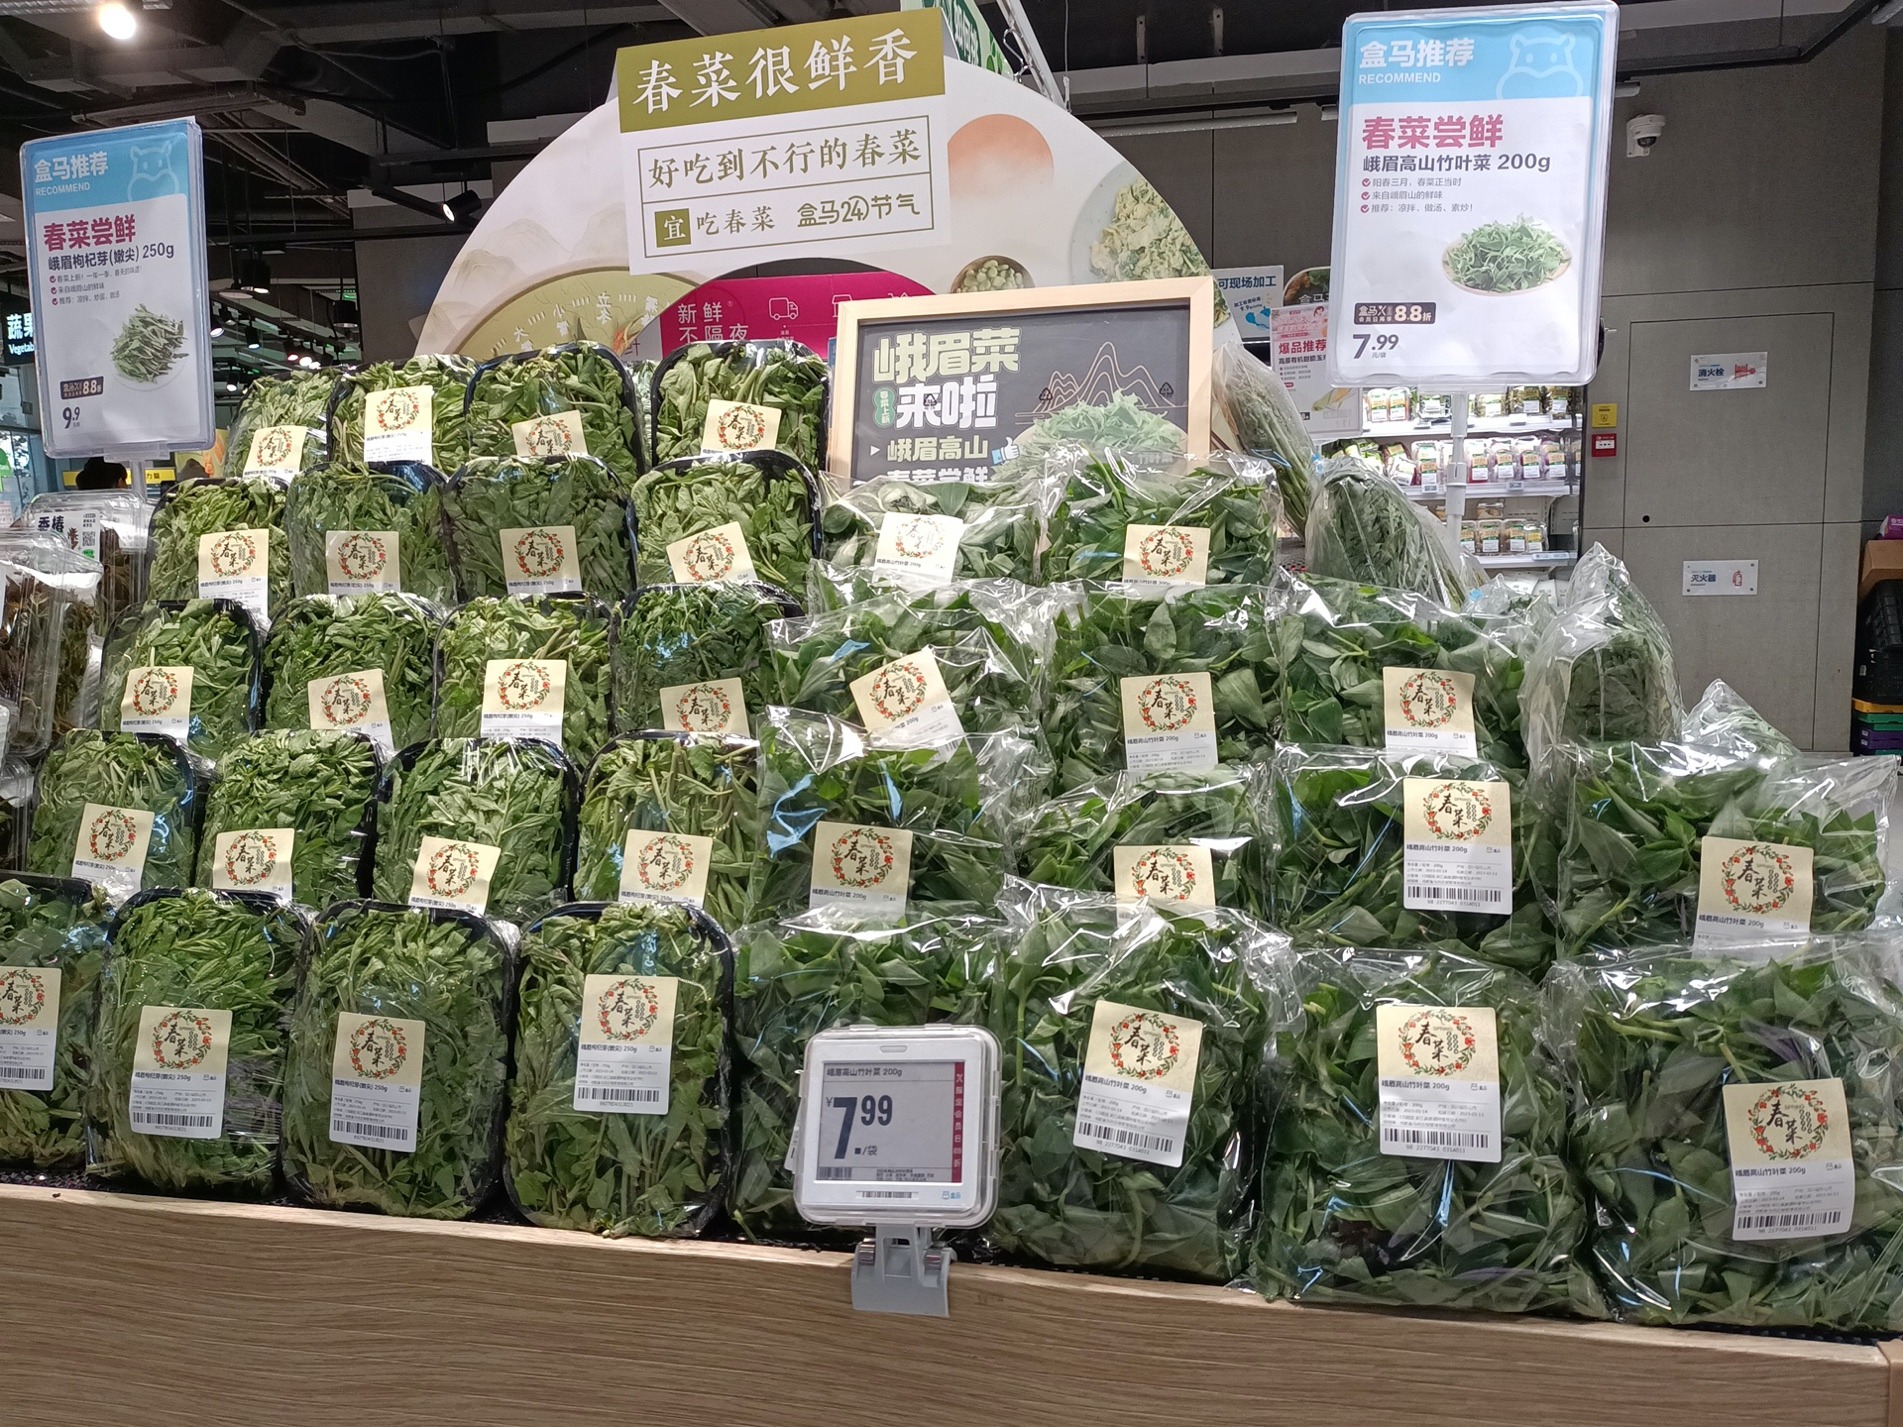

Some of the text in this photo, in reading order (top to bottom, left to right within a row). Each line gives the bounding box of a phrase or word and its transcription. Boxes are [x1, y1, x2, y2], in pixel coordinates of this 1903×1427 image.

[1359, 38, 1475, 68] 盒马推荐
[632, 27, 918, 114] 春菜很鲜香
[1358, 72, 1441, 85] RECOMMEND
[1362, 114, 1504, 150] 春菜尝鲜
[33, 151, 109, 183] 盒马推荐
[648, 128, 922, 189] 好吃到不行的春菜
[1363, 153, 1551, 173] 峨眉高山竹叶菜 200g
[35, 181, 91, 197] RECOMMEND
[1372, 190, 1443, 200] 来自峨眉山的鲜味
[663, 193, 920, 241] 宜 吃春菜 盒马24节气
[43, 213, 137, 252] 春菜尝鲜
[48, 242, 174, 271] 峨眉枸杞芽(嫩尖) 250g
[1218, 275, 1277, 290] 可现场加工
[677, 301, 723, 324] 新鲜
[678, 323, 749, 341] 不隔夜
[1352, 333, 1399, 360] 7.99
[872, 326, 1021, 384] 峨眉菜
[1278, 339, 1327, 355] 爆品推荐
[1698, 367, 1724, 377] 消火栓
[896, 373, 997, 429] 来啦
[62, 406, 80, 429] 9.9
[727, 414, 746, 441] 春菜
[887, 434, 989, 463] 峨眉高山
[220, 542, 239, 568] 春菜
[348, 542, 369, 570] 春菜
[525, 540, 548, 568] 春菜
[695, 545, 719, 570] 春菜
[1151, 537, 1171, 567] 春菜
[141, 679, 157, 706] 春菜
[508, 672, 530, 700] 春菜
[883, 678, 910, 705] 春菜
[1411, 682, 1436, 716] 春菜
[332, 688, 354, 715] 春菜
[689, 699, 713, 726] 春菜
[1151, 688, 1177, 720] 春菜
[1438, 792, 1468, 829] 春菜
[99, 820, 115, 851] 春菜
[1451, 845, 1468, 854] 200g
[235, 843, 256, 874] 春菜
[438, 854, 456, 887] 春菜
[649, 847, 672, 880] 春菜
[844, 838, 869, 876] 春菜
[1146, 859, 1174, 895] 春菜
[1737, 857, 1768, 900] 春菜
[1748, 919, 1764, 929] 200g
[2, 980, 24, 1014] 春菜
[611, 990, 635, 1028] 春菜
[164, 1022, 188, 1057] 春菜
[361, 1030, 385, 1067] 春菜
[1125, 1024, 1152, 1066] 春菜
[1415, 1021, 1449, 1062] 春菜
[883, 1068, 903, 1077] 200g
[1432, 1081, 1450, 1092] 200g
[1130, 1083, 1148, 1095] 200g
[1766, 1100, 1803, 1145] 春菜
[1788, 1167, 1806, 1175] 200g
